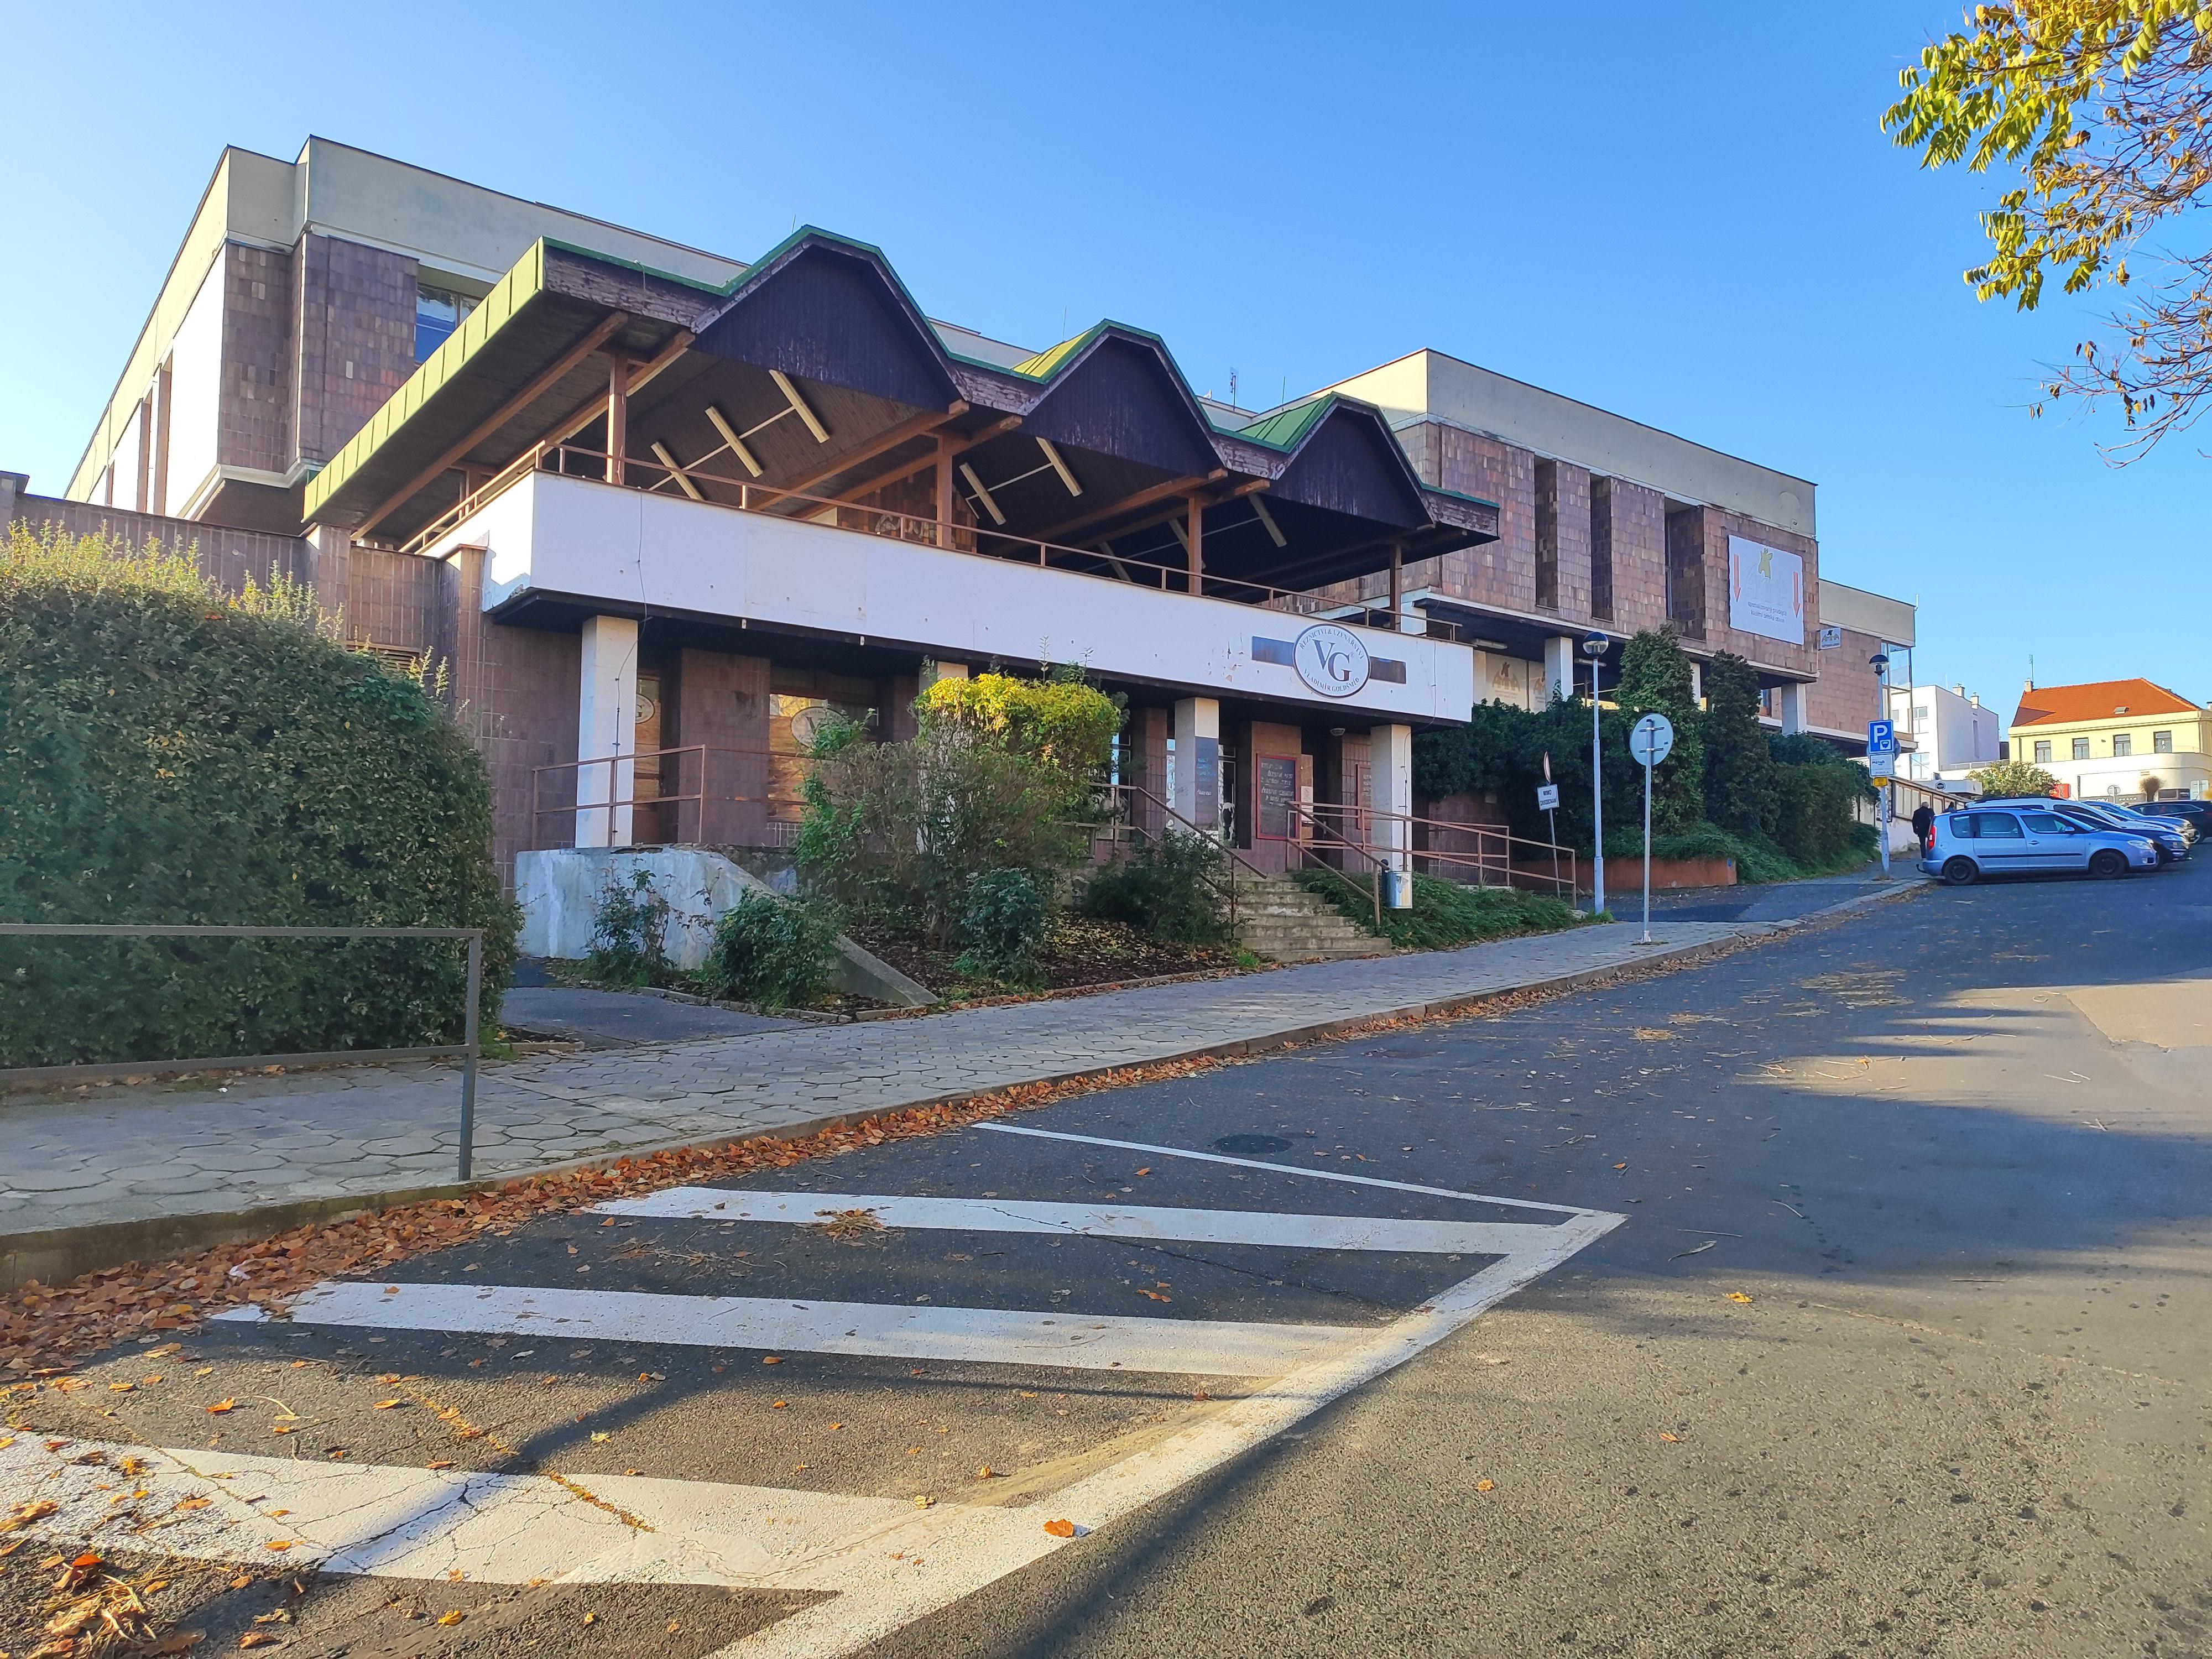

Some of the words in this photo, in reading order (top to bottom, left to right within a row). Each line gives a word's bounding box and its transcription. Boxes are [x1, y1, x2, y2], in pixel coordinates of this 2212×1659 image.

[1312, 639, 1353, 682] VG
[1304, 668, 1331, 691] VLADIMÍR
[1874, 724, 1888, 743] P
